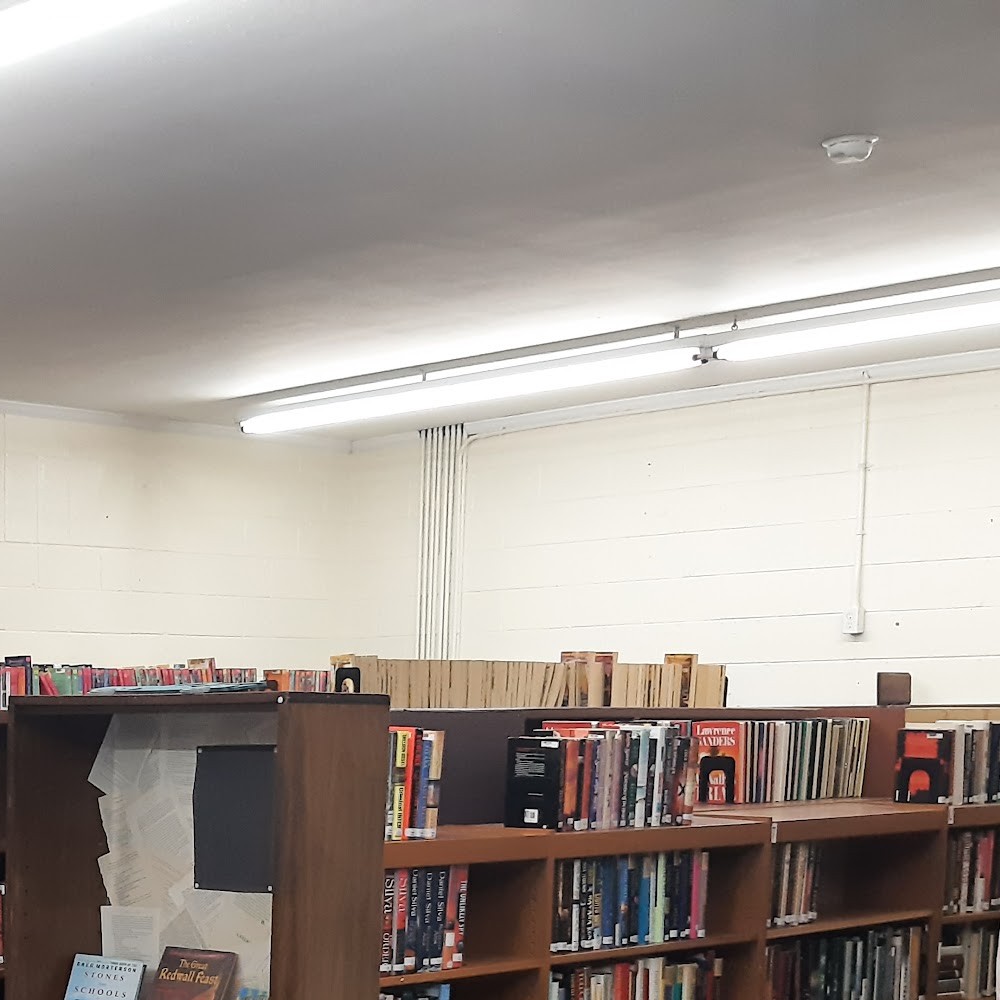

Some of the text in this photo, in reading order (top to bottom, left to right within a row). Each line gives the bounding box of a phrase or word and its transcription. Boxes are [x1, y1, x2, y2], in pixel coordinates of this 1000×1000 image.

[697, 725, 735, 735] Lawrence
[438, 871, 446, 898] Daniel
[383, 878, 395, 914] Silva
[398, 878, 407, 913] Silva
[179, 959, 209, 970] The Great
[85, 972, 124, 981] STONES
[159, 967, 195, 983] Redwall
[75, 986, 126, 998] SCHOOLS
